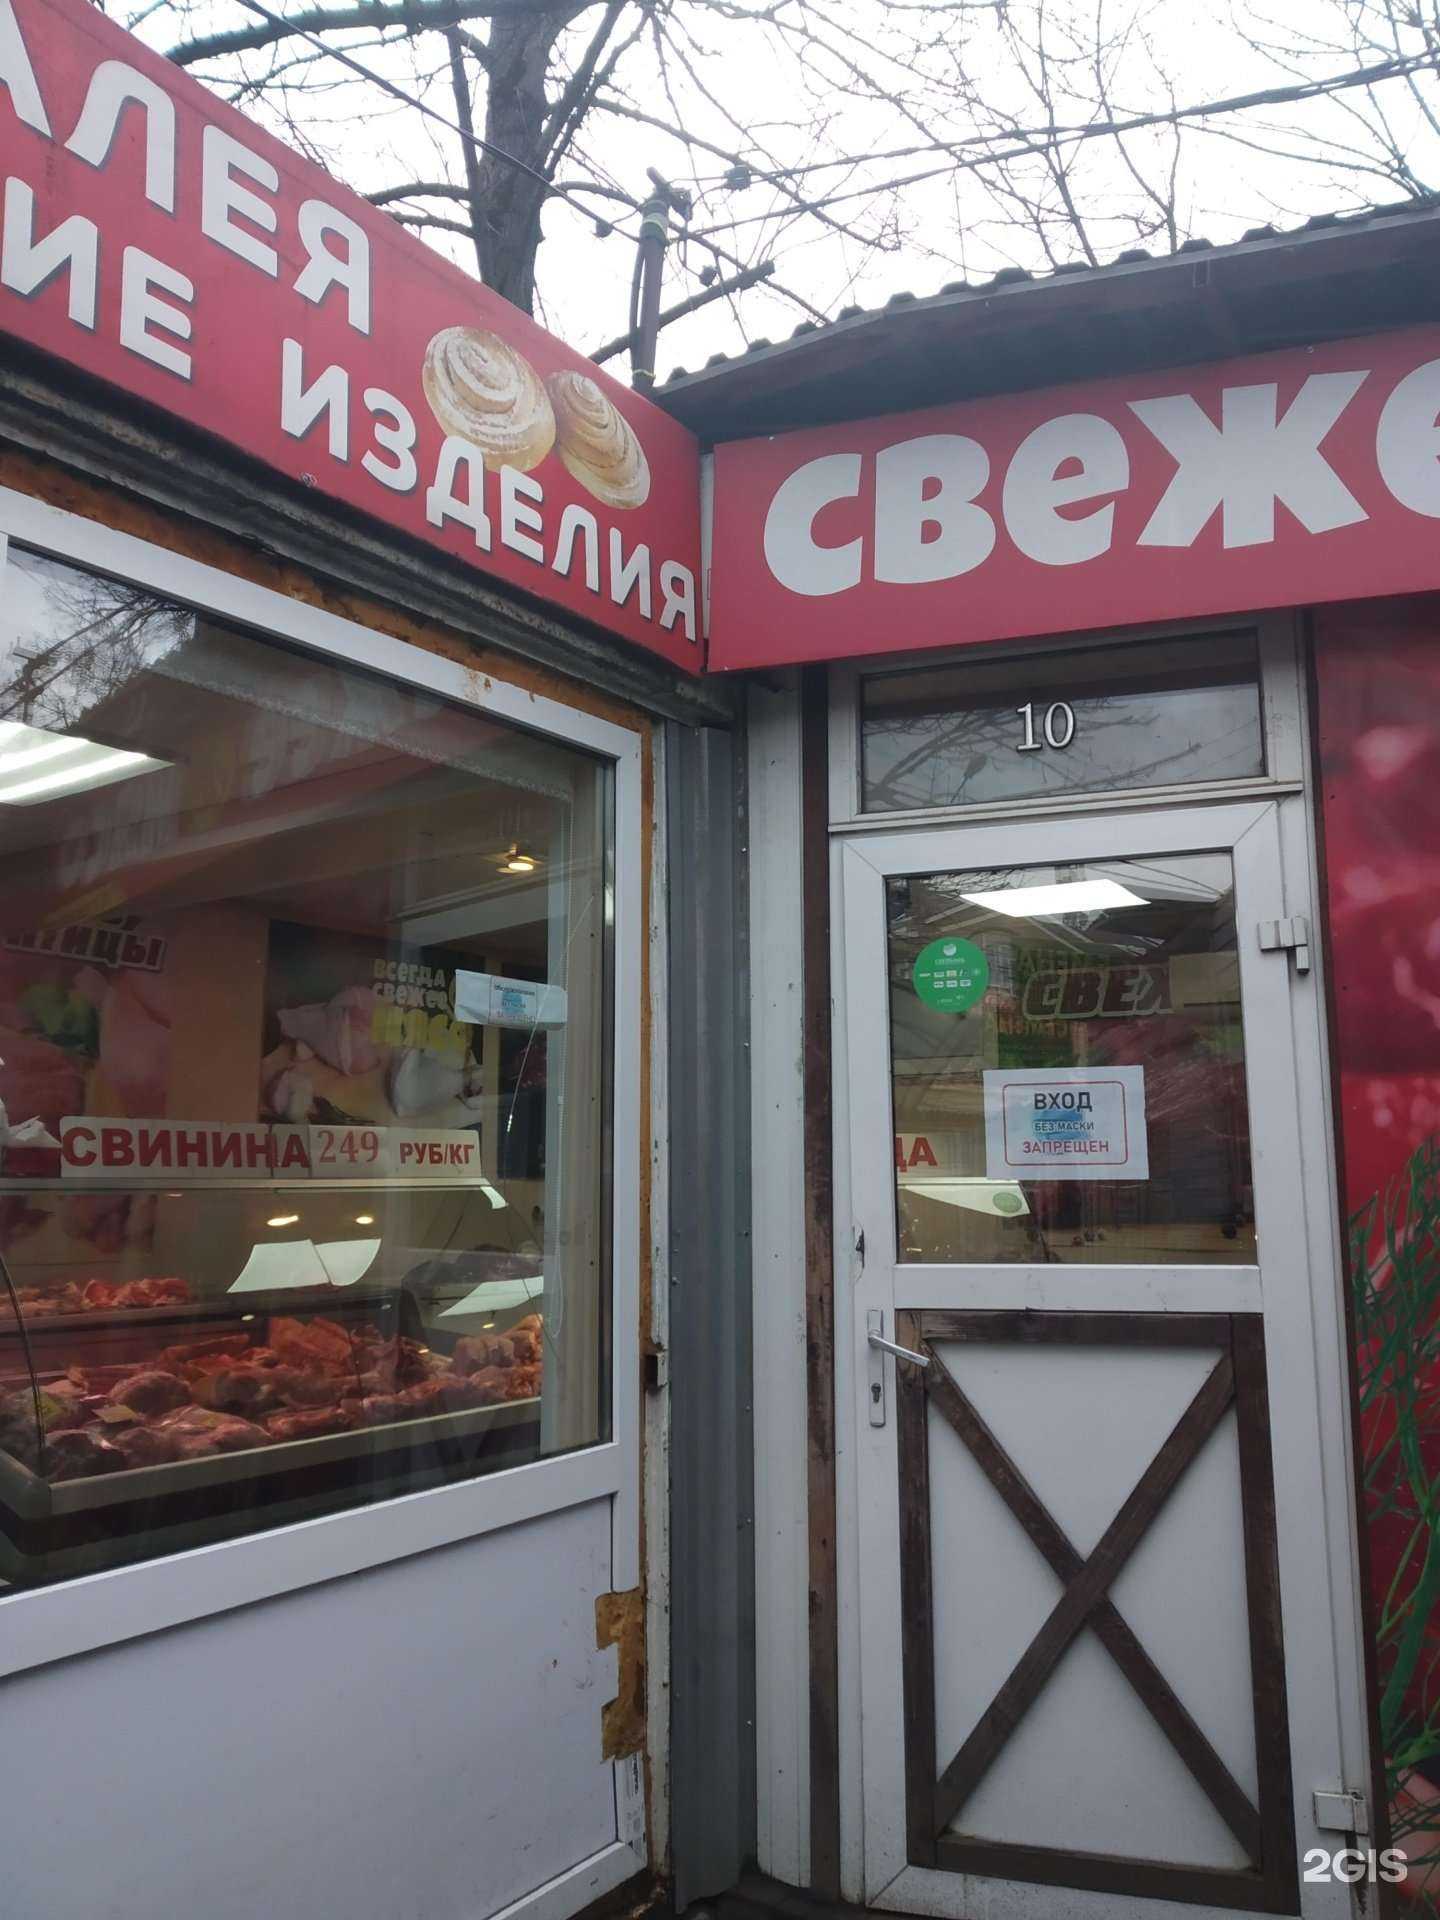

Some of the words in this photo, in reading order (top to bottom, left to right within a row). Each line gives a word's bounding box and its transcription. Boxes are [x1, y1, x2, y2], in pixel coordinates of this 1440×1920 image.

[281, 337, 698, 642] ИЗДЕЛИЯ
[1016, 702, 1077, 752] 10
[1034, 1091, 1093, 1112] ВХОД
[1034, 1122, 1055, 1132] БЕЗ
[1057, 1121, 1094, 1131] МАСКИ
[61, 1126, 309, 1169] СВИНИНА
[316, 1129, 379, 1164] 249
[400, 1142, 475, 1165] РУБ/КГ
[1023, 1140, 1109, 1155] ЗАПРЕЩЕН
